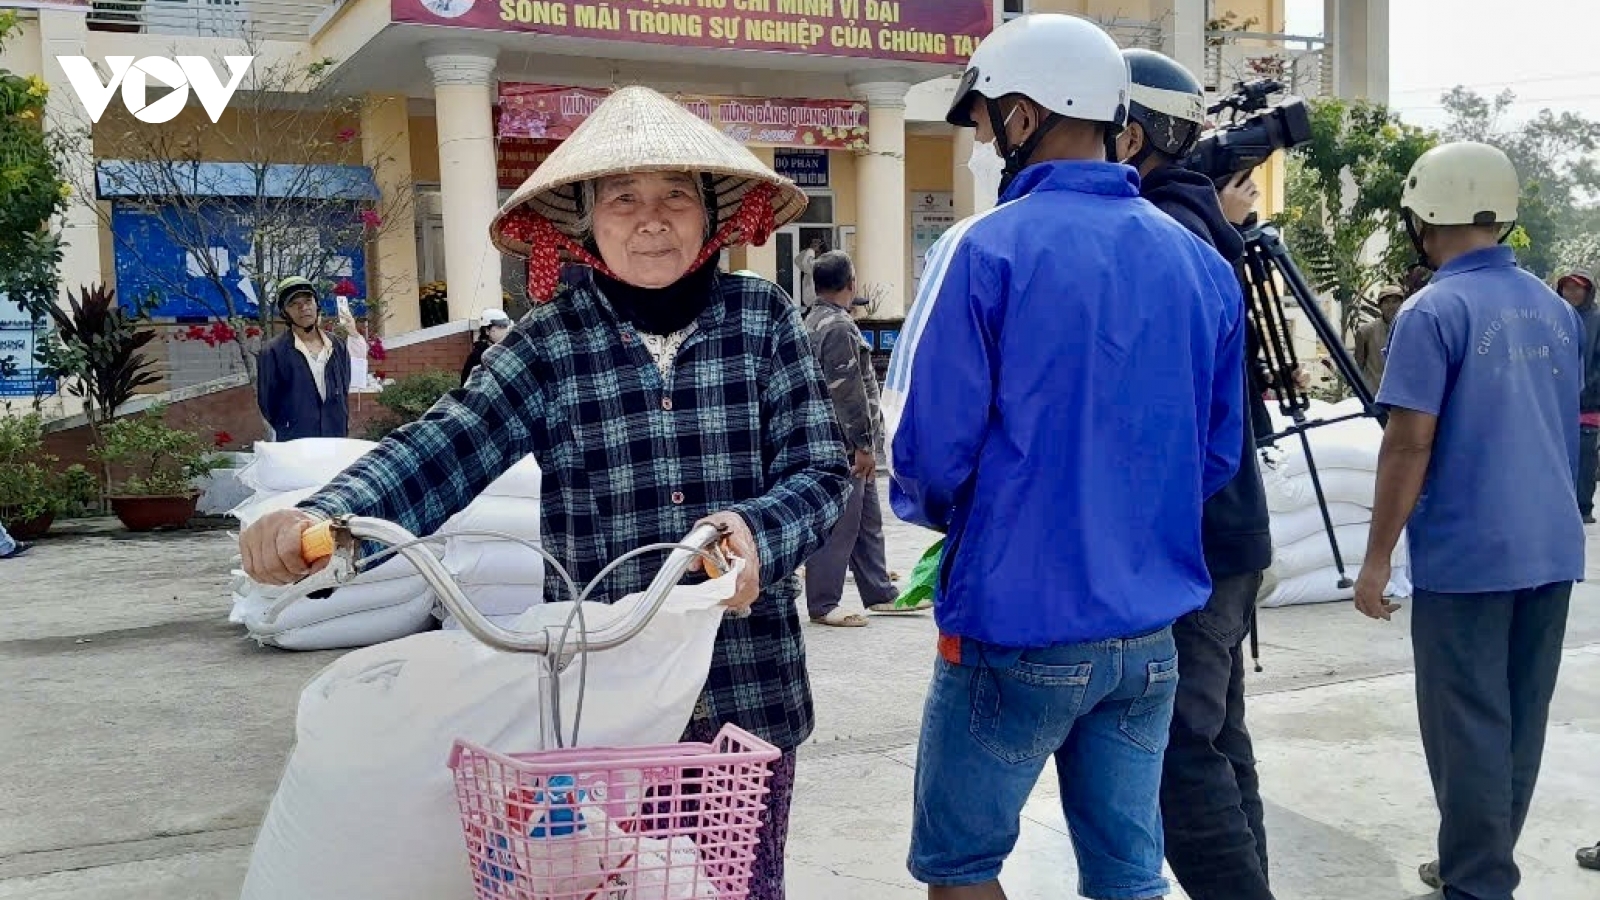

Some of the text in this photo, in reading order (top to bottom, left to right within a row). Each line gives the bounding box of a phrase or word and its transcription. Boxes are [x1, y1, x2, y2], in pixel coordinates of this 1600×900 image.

[865, 0, 900, 26] ĐẠI
[575, 3, 620, 30] MÃI
[627, 9, 702, 37] TRONG
[709, 16, 741, 44] SỰ
[745, 17, 824, 50] NGHIỆP
[831, 19, 872, 49] CỦA
[878, 27, 946, 55] CHÚNG
[789, 106, 827, 127] QUANG
